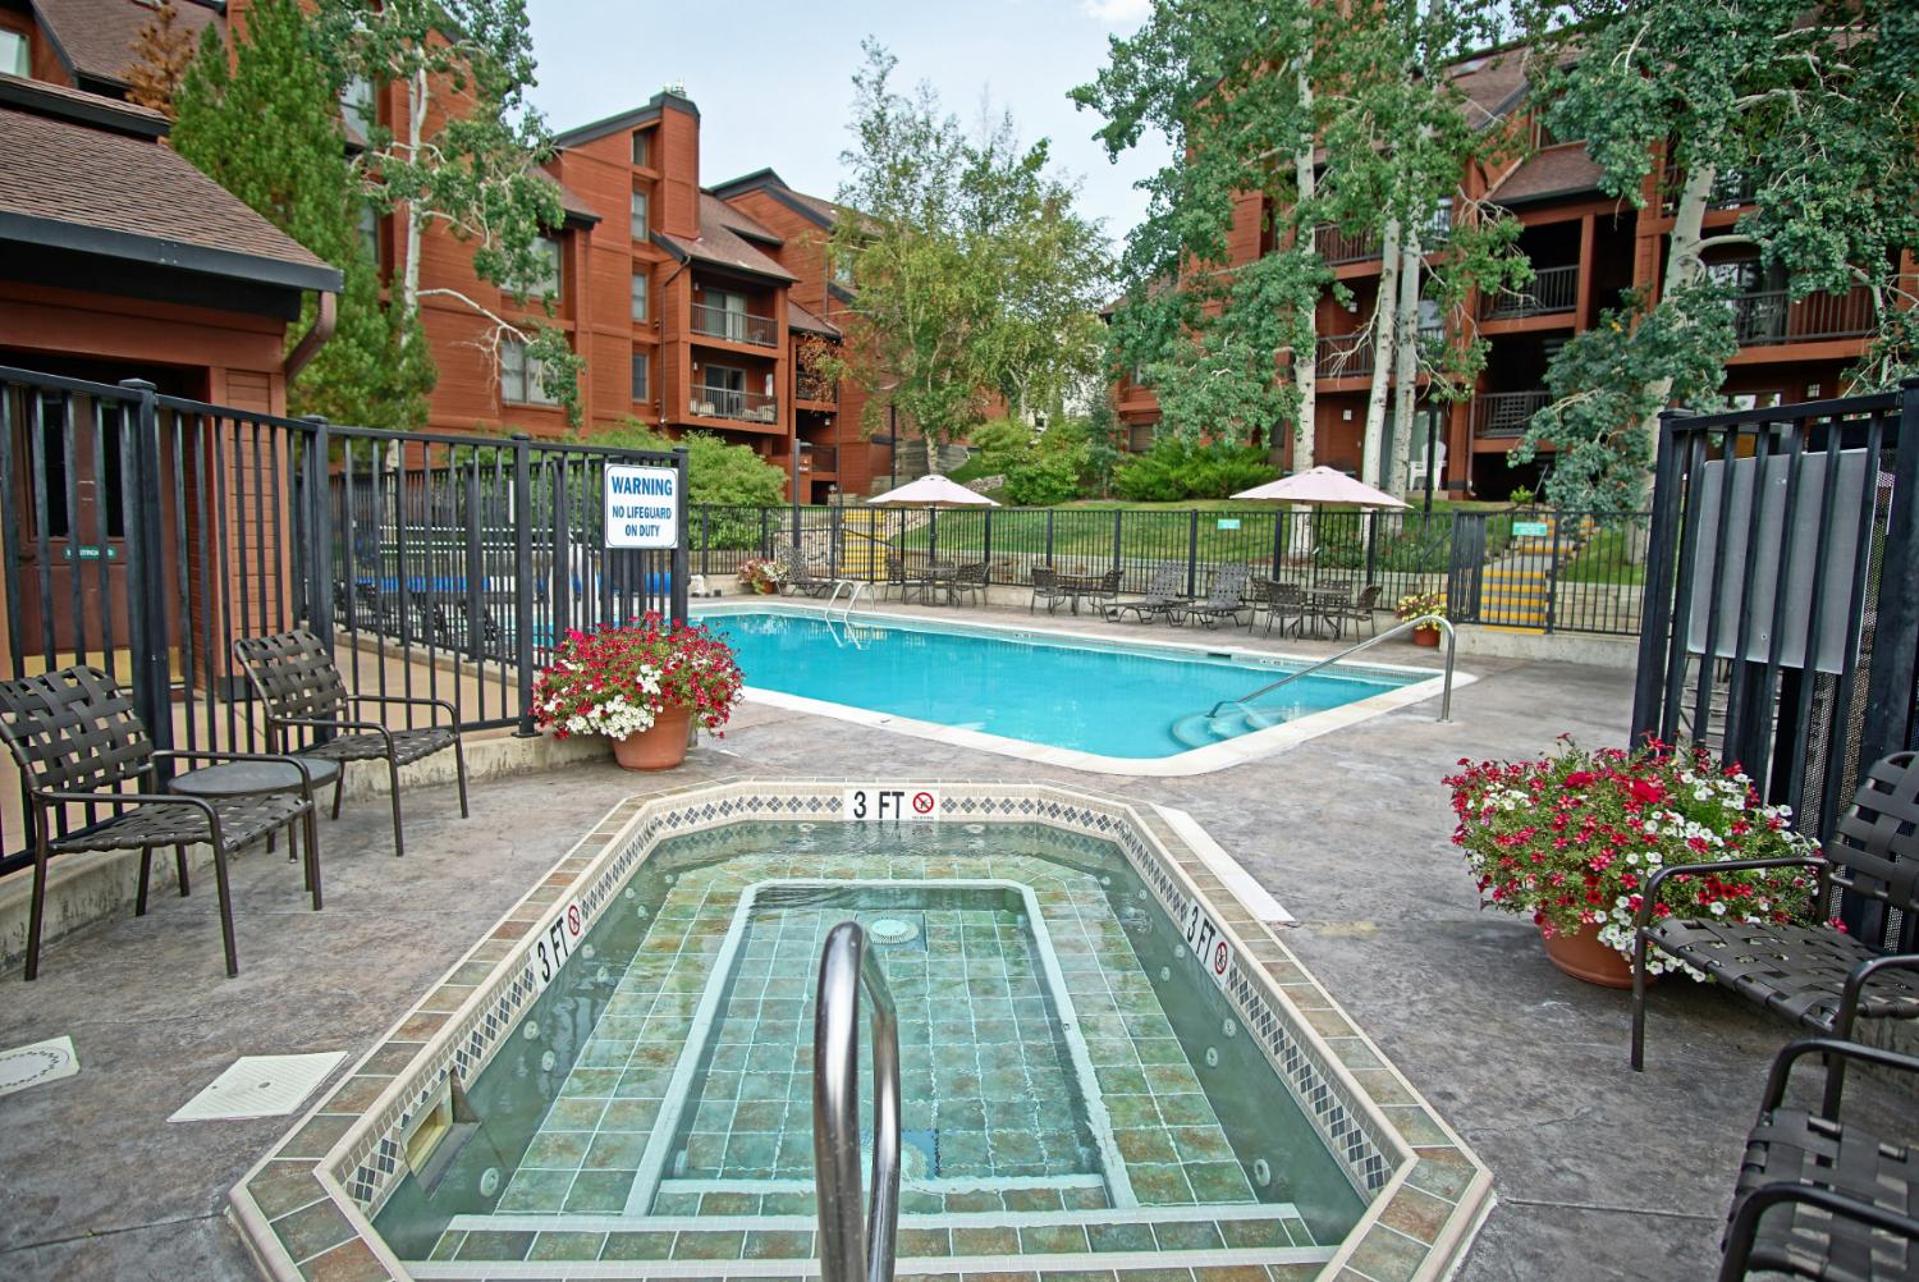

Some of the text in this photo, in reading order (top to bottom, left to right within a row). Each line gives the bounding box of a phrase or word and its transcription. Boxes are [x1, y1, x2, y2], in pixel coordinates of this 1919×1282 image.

[611, 476, 673, 496] WARNING
[612, 506, 672, 520] NO LIFEGUARD
[625, 524, 660, 537] ON DUTY
[854, 791, 905, 819] 3 FT
[1187, 906, 1198, 942] 3
[1196, 917, 1216, 964] FT
[538, 916, 568, 983] 3 FT
